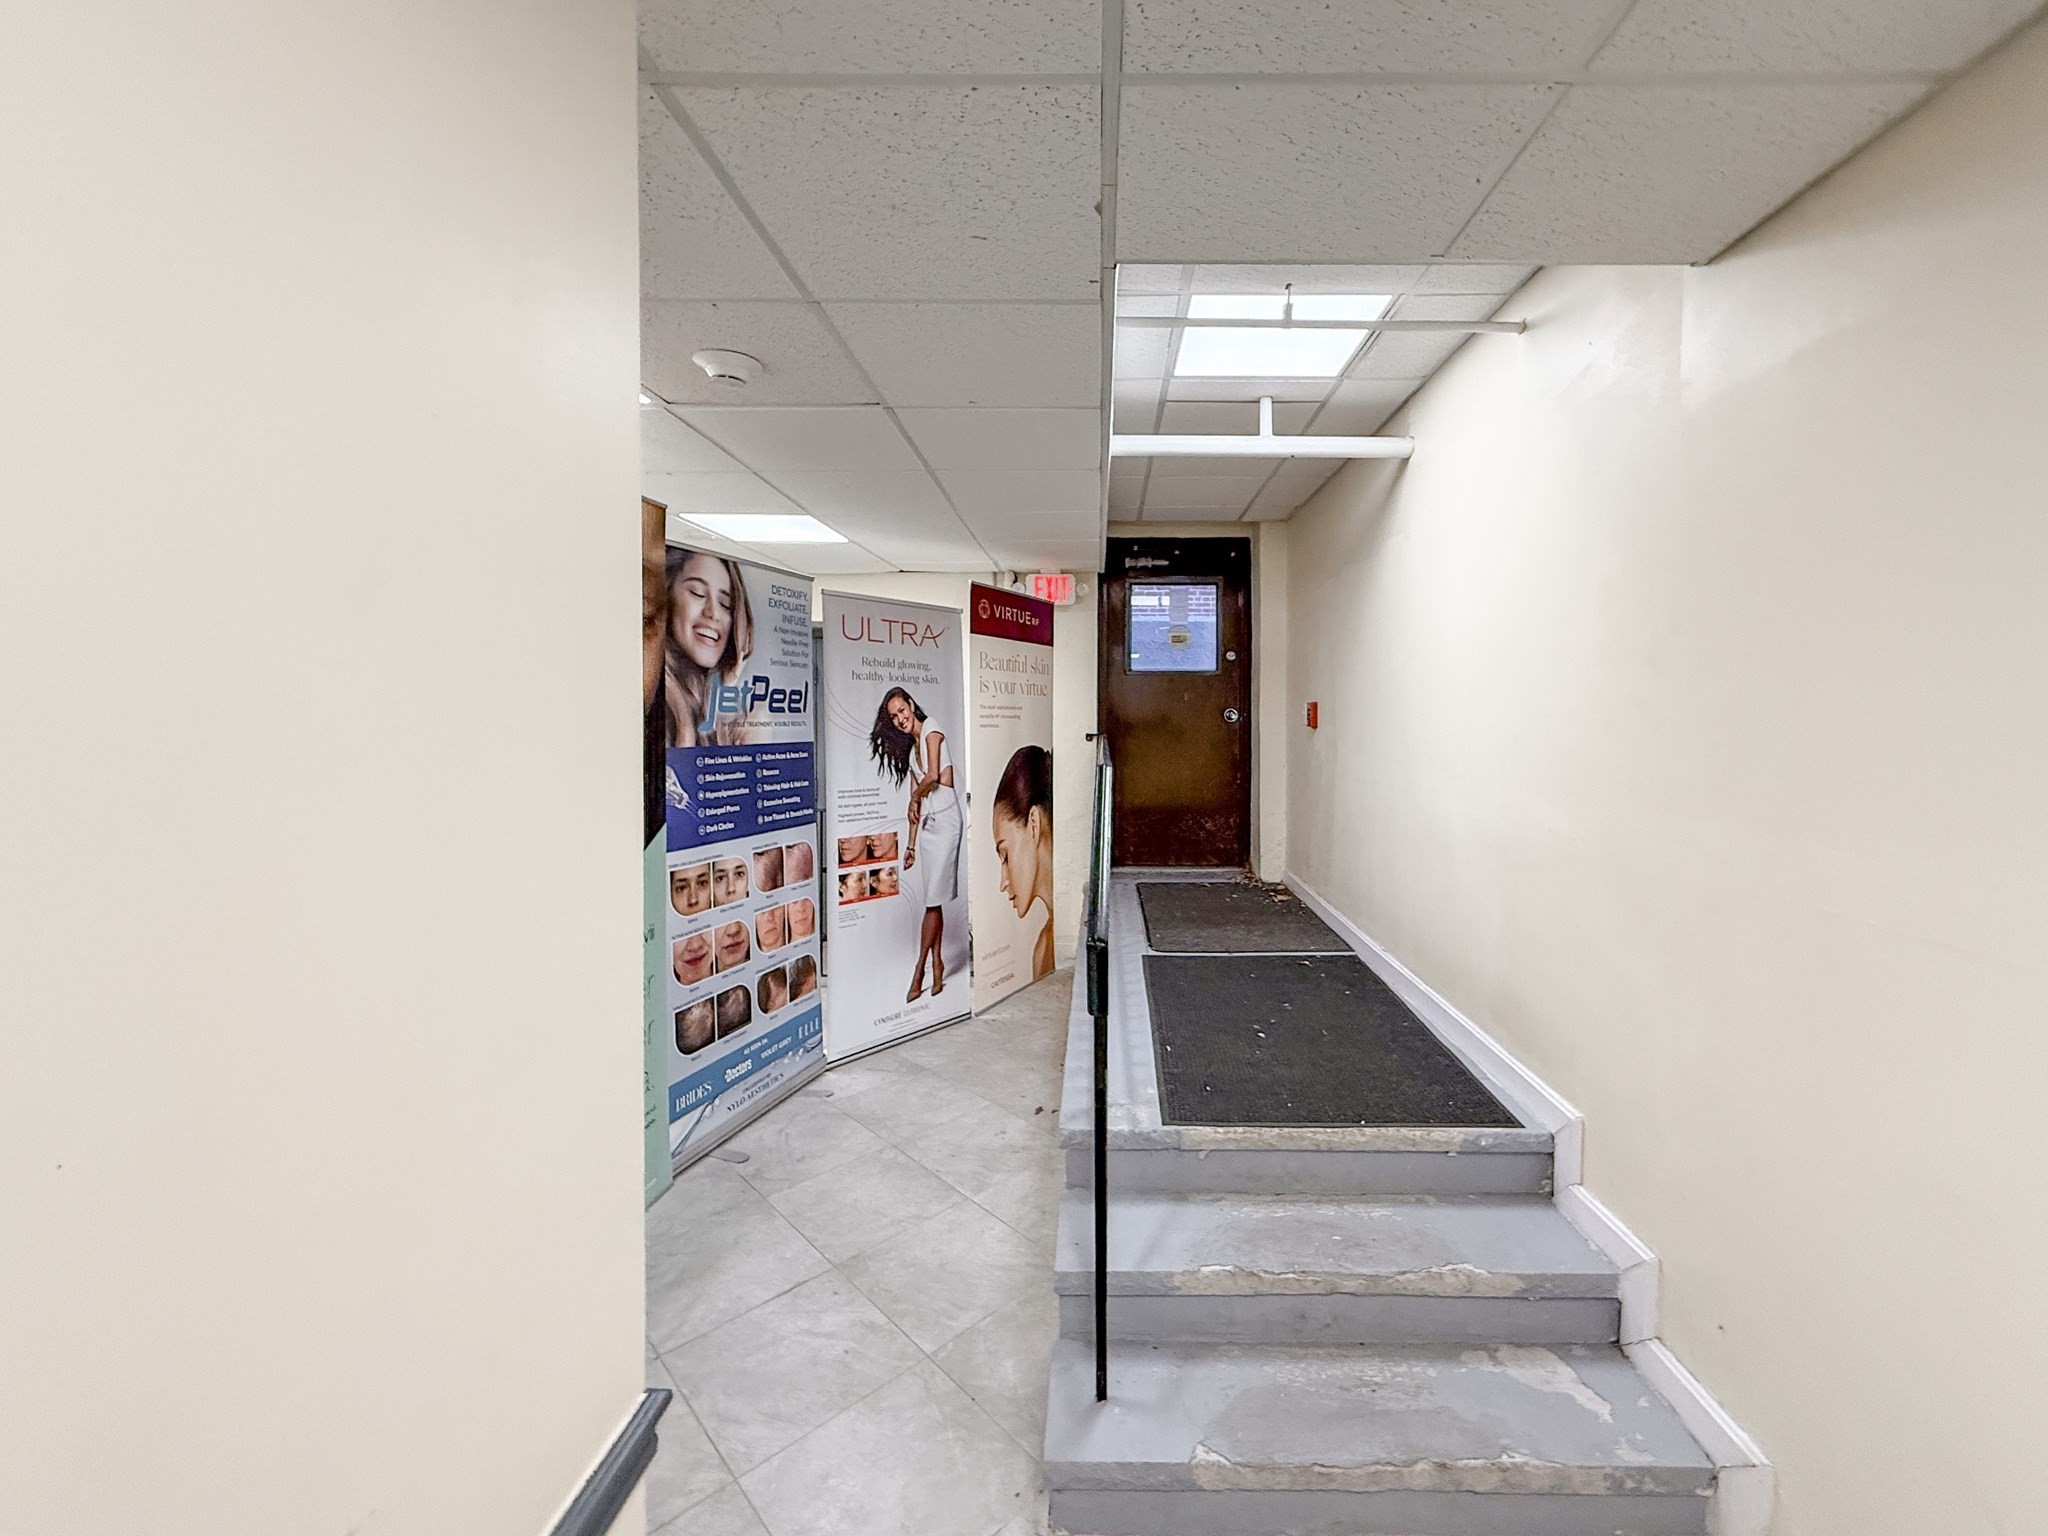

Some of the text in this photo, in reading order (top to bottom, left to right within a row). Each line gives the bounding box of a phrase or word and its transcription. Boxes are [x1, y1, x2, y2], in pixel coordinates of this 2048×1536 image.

[772, 585, 808, 601] DETOXIFY.
[1034, 575, 1070, 603] EXIT
[768, 598, 808, 614] EXFOLIATE.
[994, 604, 1032, 626] VIRTUE
[782, 614, 808, 627] INFUSE.
[842, 613, 945, 648] ULTRA
[862, 656, 932, 673] Rebuild glowing,
[980, 651, 1050, 676] Beautiful skin
[921, 674, 940, 685] skin.
[980, 676, 1048, 698] is your virtue
[675, 1081, 712, 1113] BRIDES
